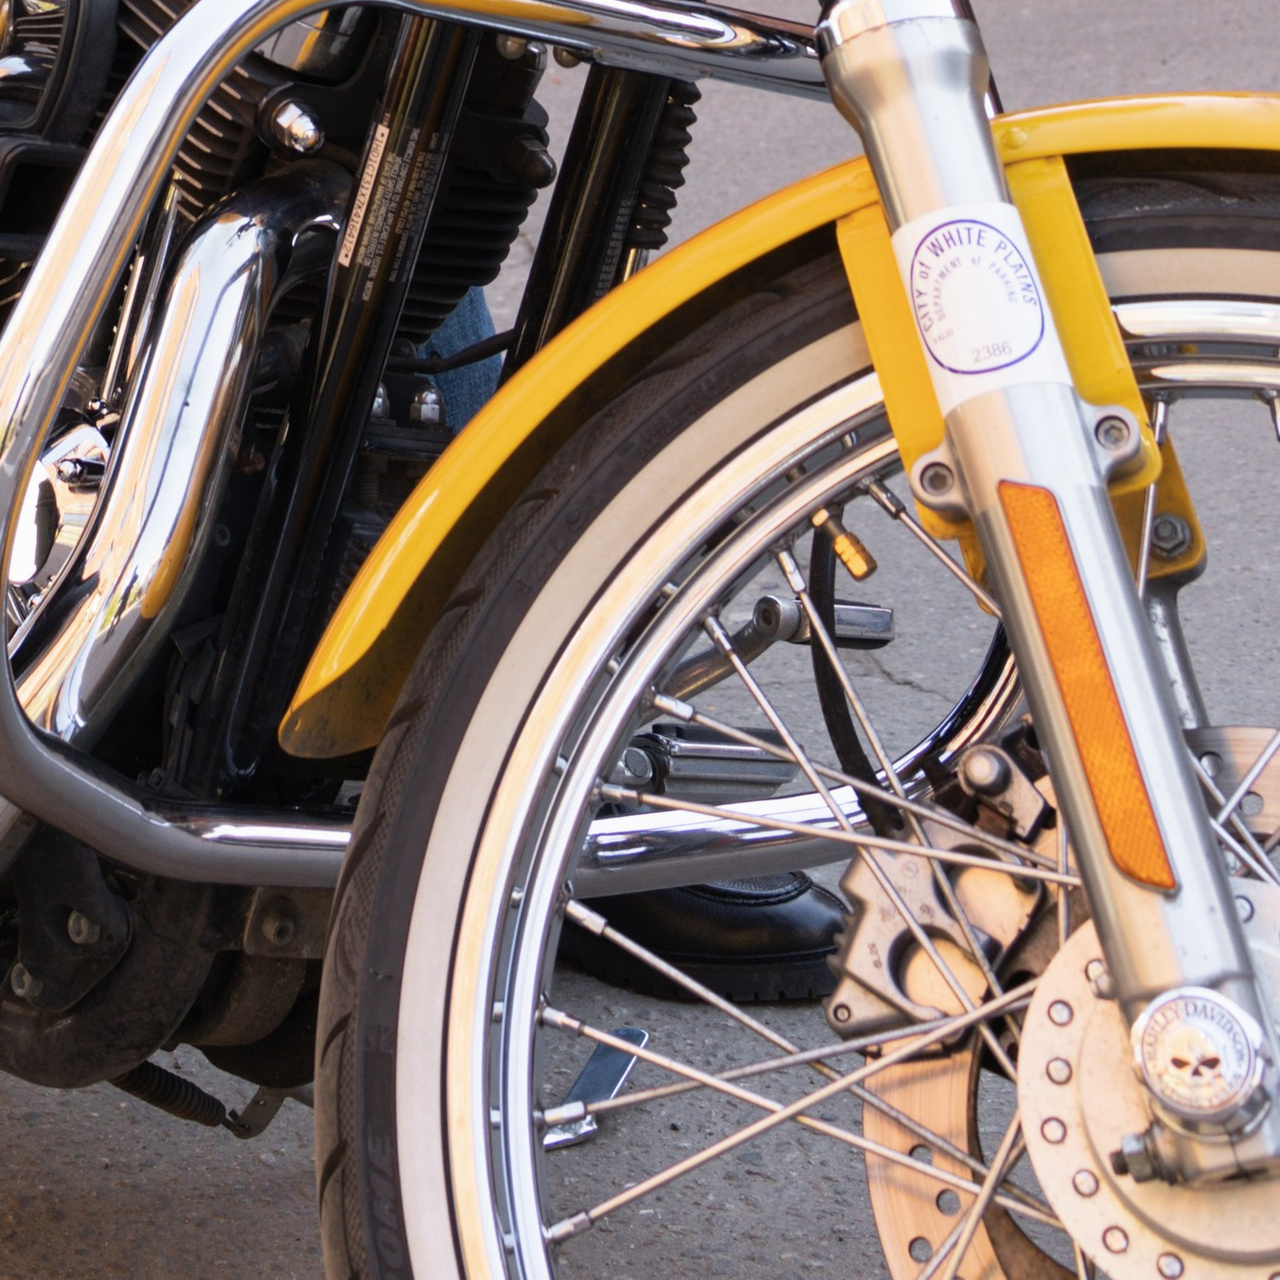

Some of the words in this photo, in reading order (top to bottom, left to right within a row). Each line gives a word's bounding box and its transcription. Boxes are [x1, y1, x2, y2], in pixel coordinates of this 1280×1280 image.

[915, 288, 934, 333] CITY
[926, 226, 988, 258] WHITE
[994, 240, 1038, 307] PLAINS
[971, 341, 1013, 364] 2386
